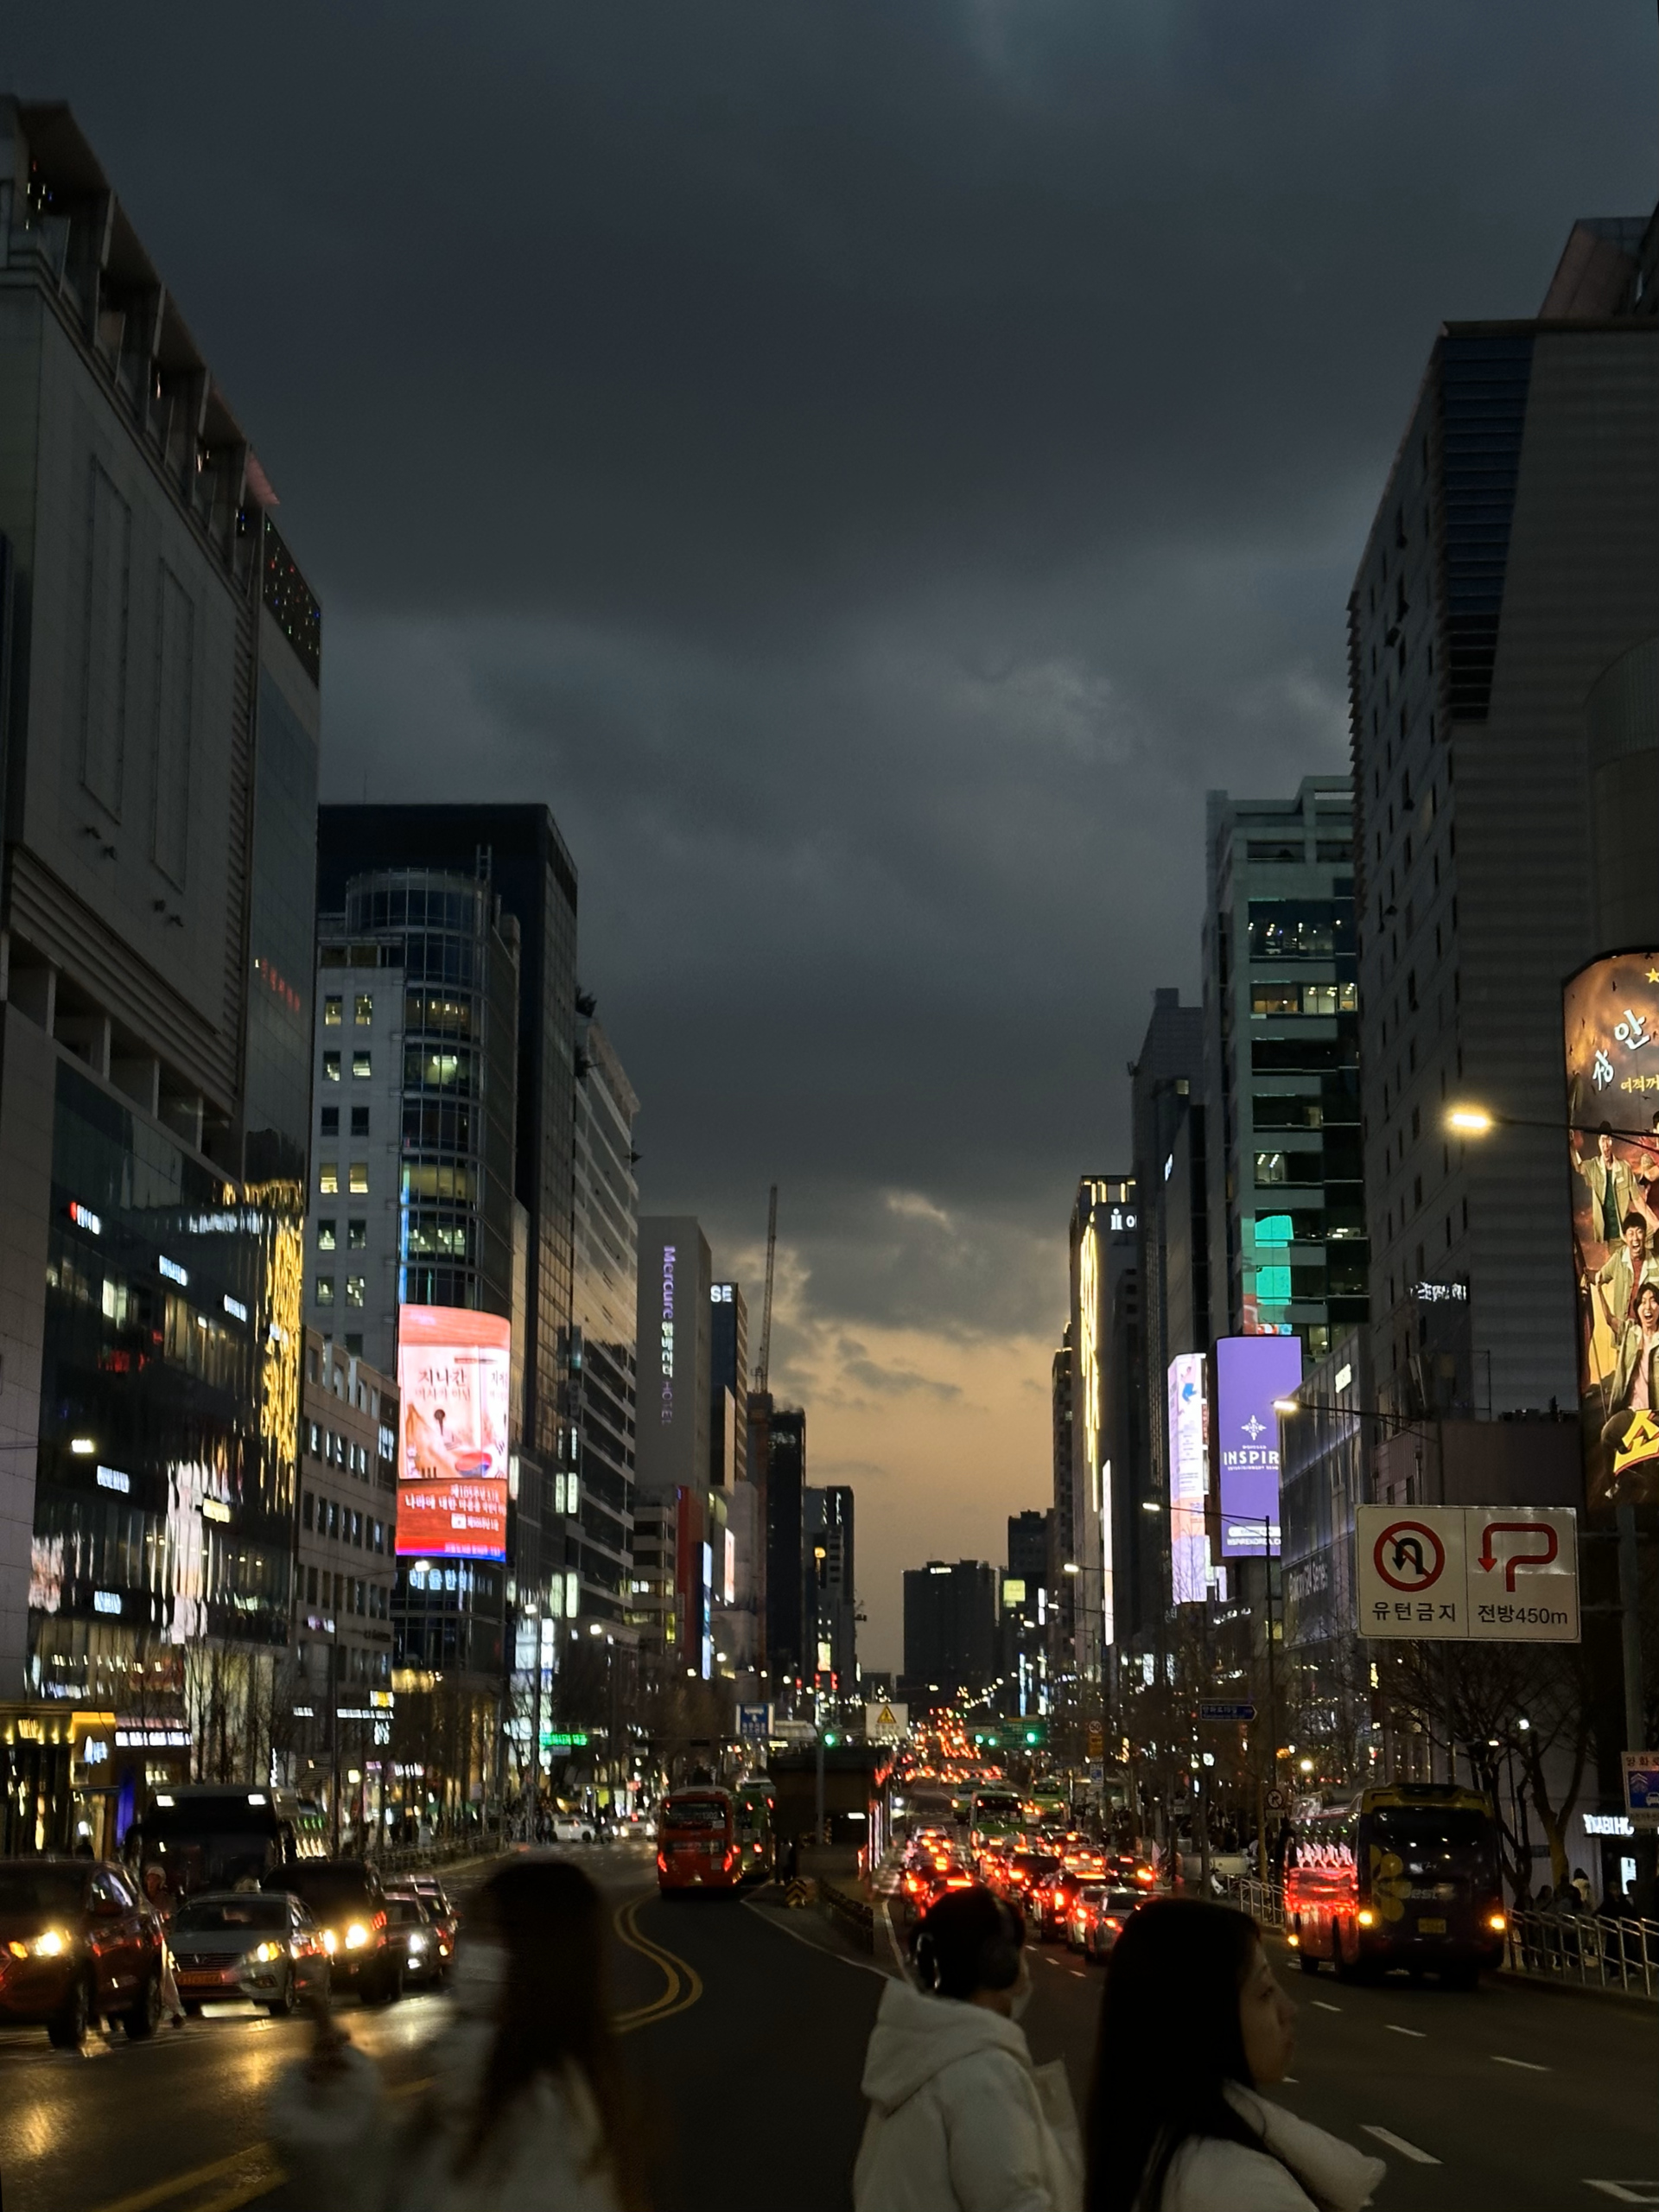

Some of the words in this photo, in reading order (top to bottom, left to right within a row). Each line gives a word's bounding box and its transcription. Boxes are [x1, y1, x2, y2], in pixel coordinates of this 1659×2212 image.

[662, 1245, 676, 1319] Mercure
[417, 1366, 467, 1387] 지나간
[661, 1381, 673, 1425] HOTEL
[1372, 1601, 1456, 1622] 유턴금지
[1478, 1605, 1567, 1624] 전방450m
